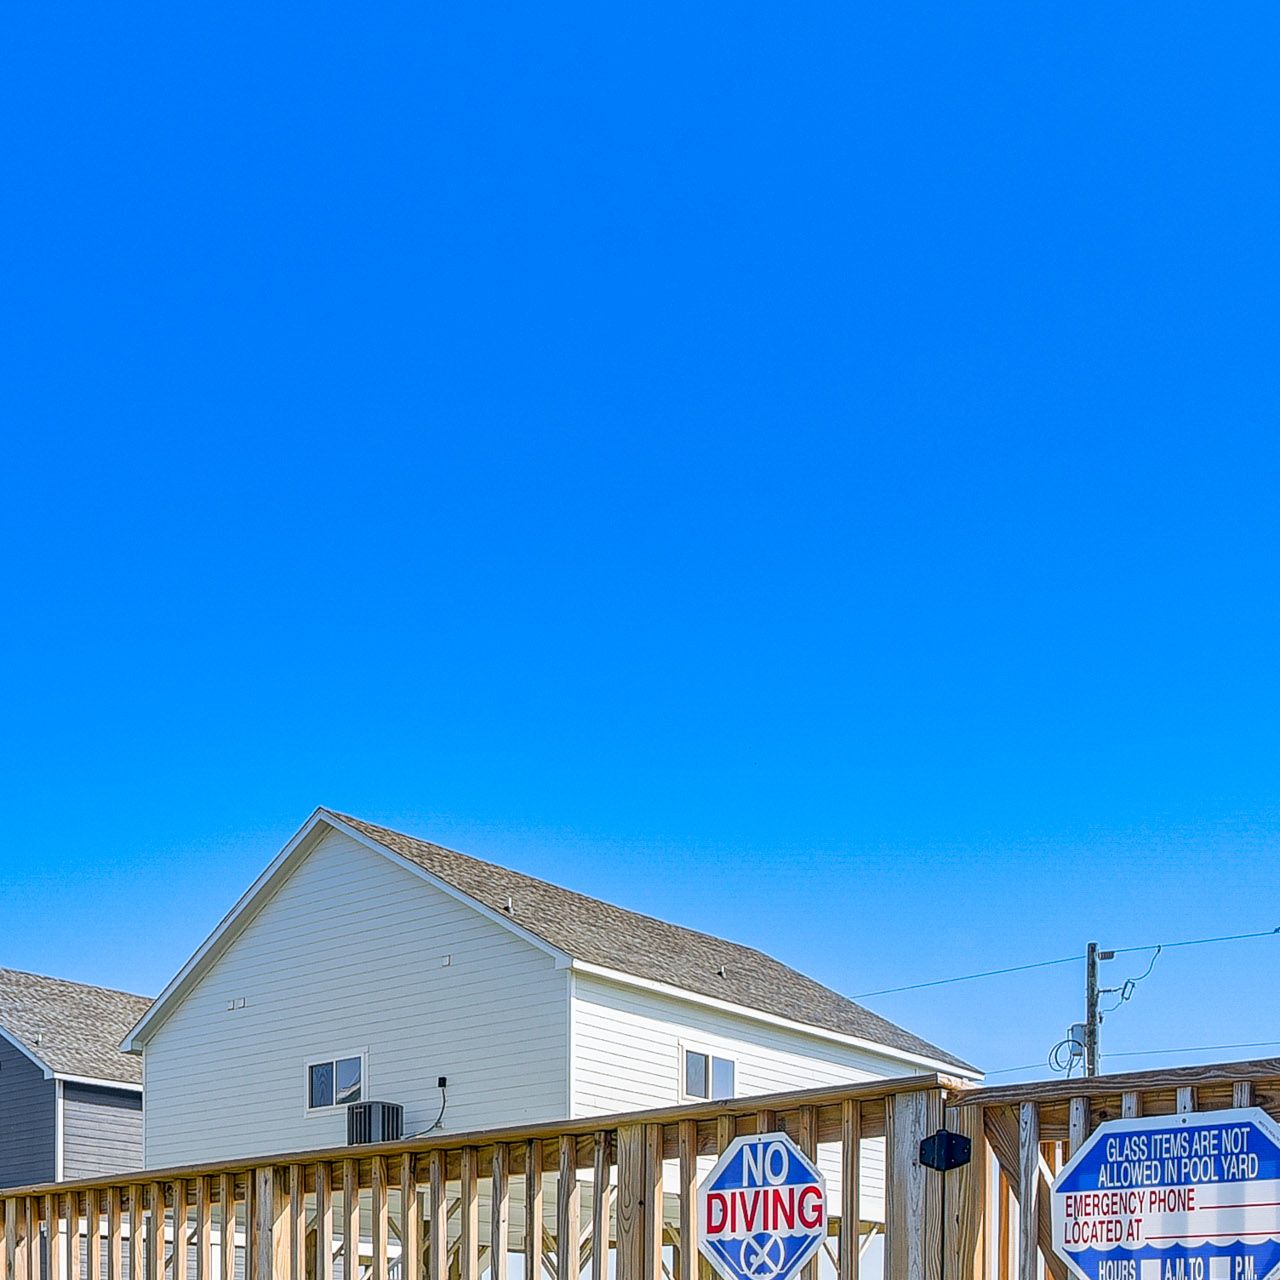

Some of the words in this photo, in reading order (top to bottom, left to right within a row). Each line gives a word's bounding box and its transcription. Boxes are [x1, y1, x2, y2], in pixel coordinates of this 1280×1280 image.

[1107, 1135, 1147, 1161] GLASS
[1150, 1132, 1189, 1159] ITEMS
[1192, 1130, 1217, 1155] ARE
[1221, 1128, 1250, 1153] NOT
[743, 1142, 789, 1187] NO
[1098, 1160, 1160, 1188] ALLOWED
[1165, 1160, 1179, 1183] IN
[1182, 1157, 1218, 1182] POOL
[1221, 1154, 1257, 1179] YARD
[707, 1186, 822, 1234] DIVING
[1066, 1191, 1145, 1217] EMERGENCY
[1150, 1189, 1195, 1212] PHONE
[1064, 1220, 1122, 1244] LOCATED
[1126, 1219, 1142, 1241] AT
[1235, 1256, 1257, 1280] P.M.
